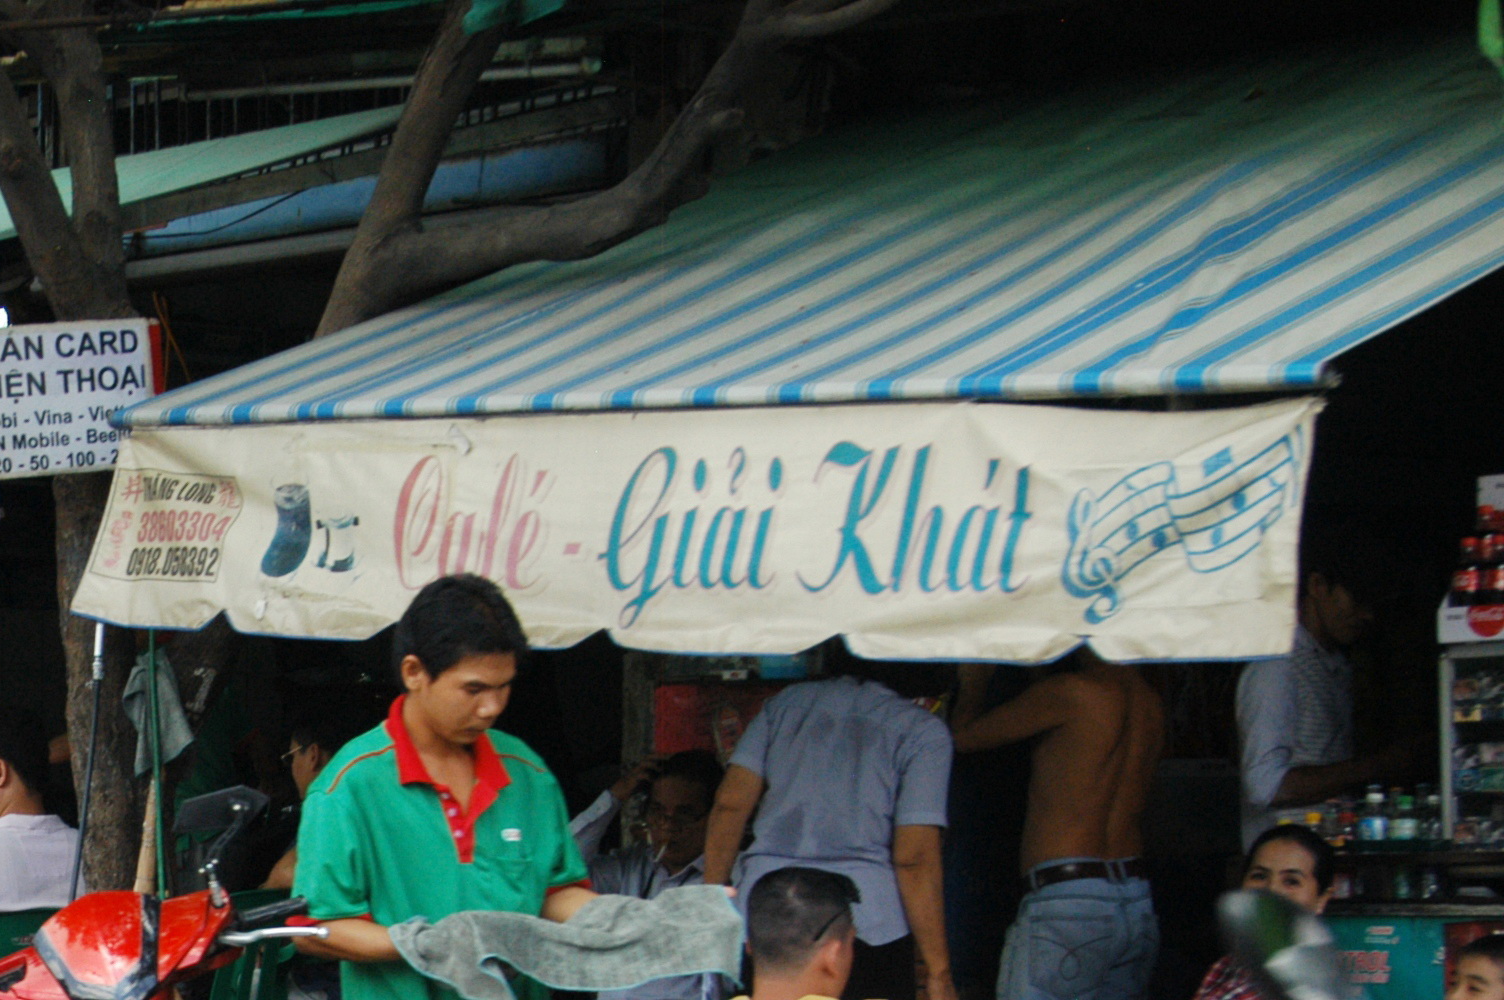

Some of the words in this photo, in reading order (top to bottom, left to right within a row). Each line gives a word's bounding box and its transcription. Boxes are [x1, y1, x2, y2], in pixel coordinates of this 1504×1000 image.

[55, 329, 138, 358] CARD
[56, 364, 146, 397] THOẠI
[34, 409, 73, 426] Vina
[12, 432, 70, 450] Mobile
[30, 454, 50, 471] 50
[67, 450, 95, 468] 100
[177, 480, 217, 505] LONG
[597, 446, 784, 629] Giải
[796, 441, 1033, 595] Khát
